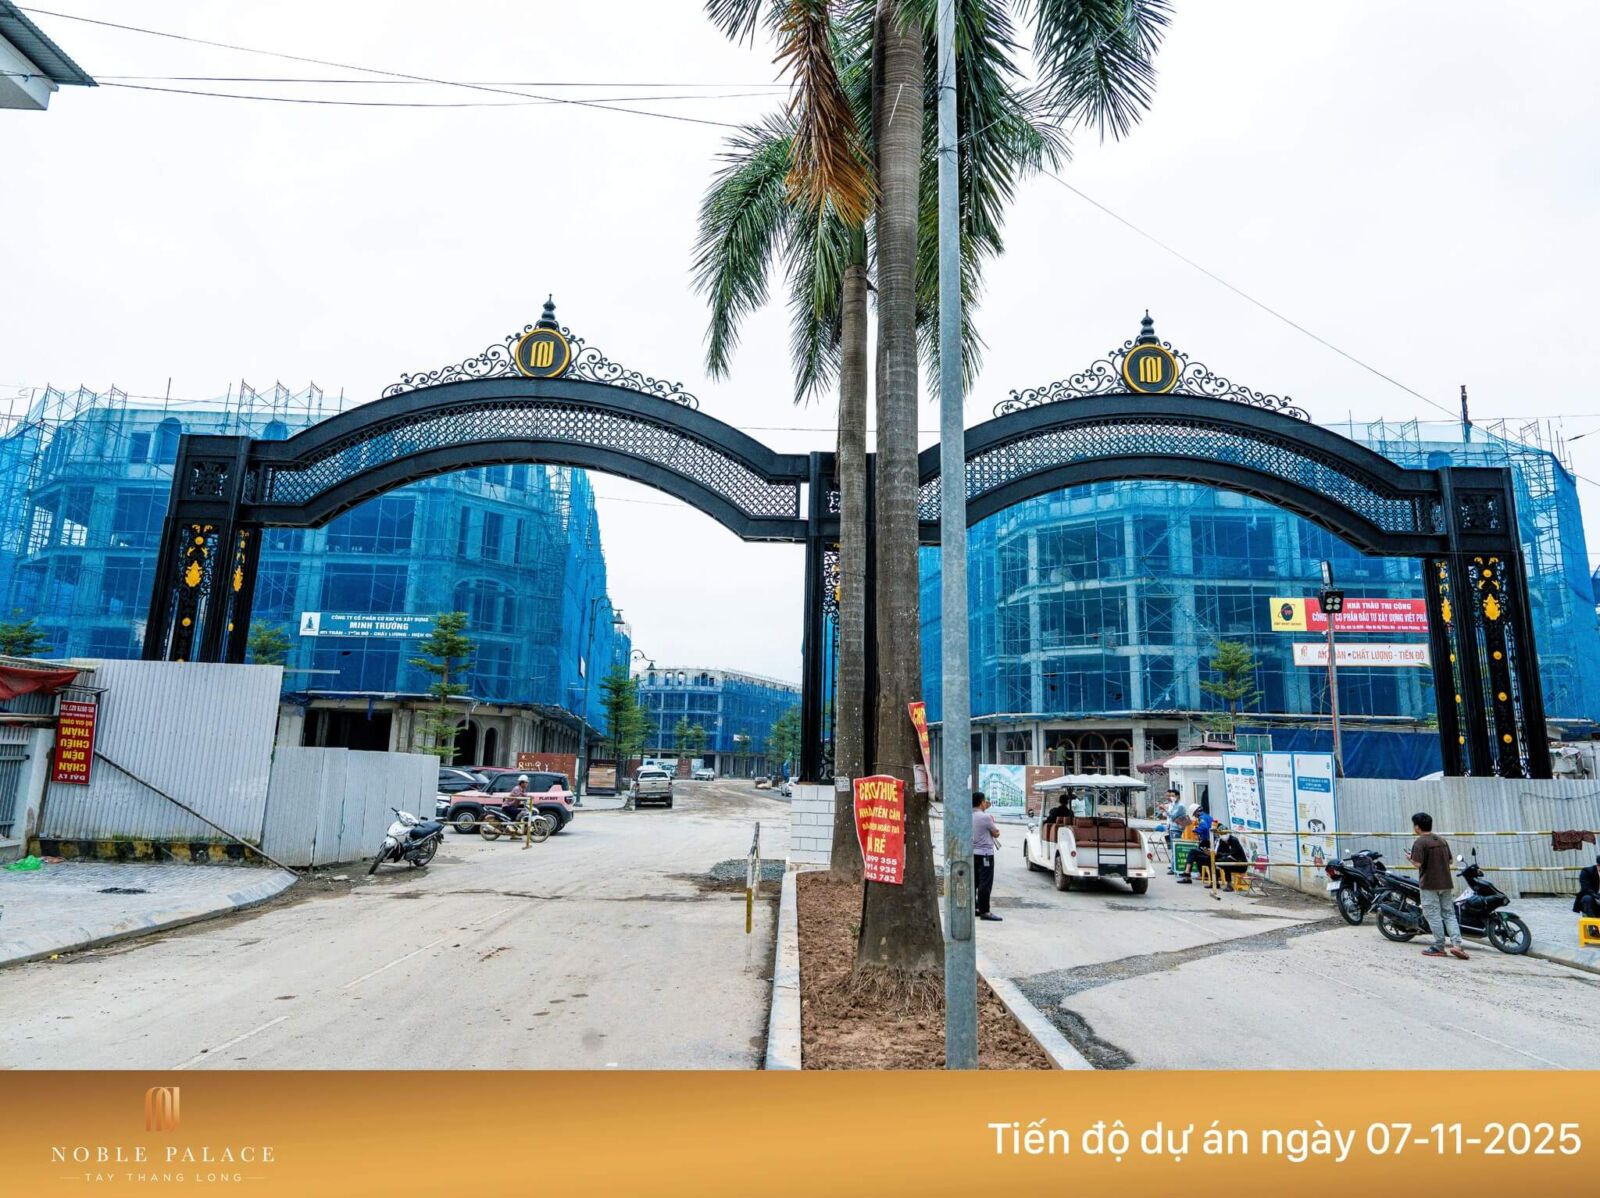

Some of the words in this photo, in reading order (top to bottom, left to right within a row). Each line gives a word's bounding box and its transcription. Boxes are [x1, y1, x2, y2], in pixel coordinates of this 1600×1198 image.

[375, 622, 409, 630] TRƯỜNG
[1352, 648, 1369, 659] CHẤT
[1371, 650, 1392, 661] LƯỢNG
[1399, 649, 1414, 659] TIẾN
[1416, 650, 1424, 661] ĐỘ
[60, 739, 89, 750] CHIẾU
[63, 750, 85, 761] ĐỆM
[874, 834, 886, 853] RẺ
